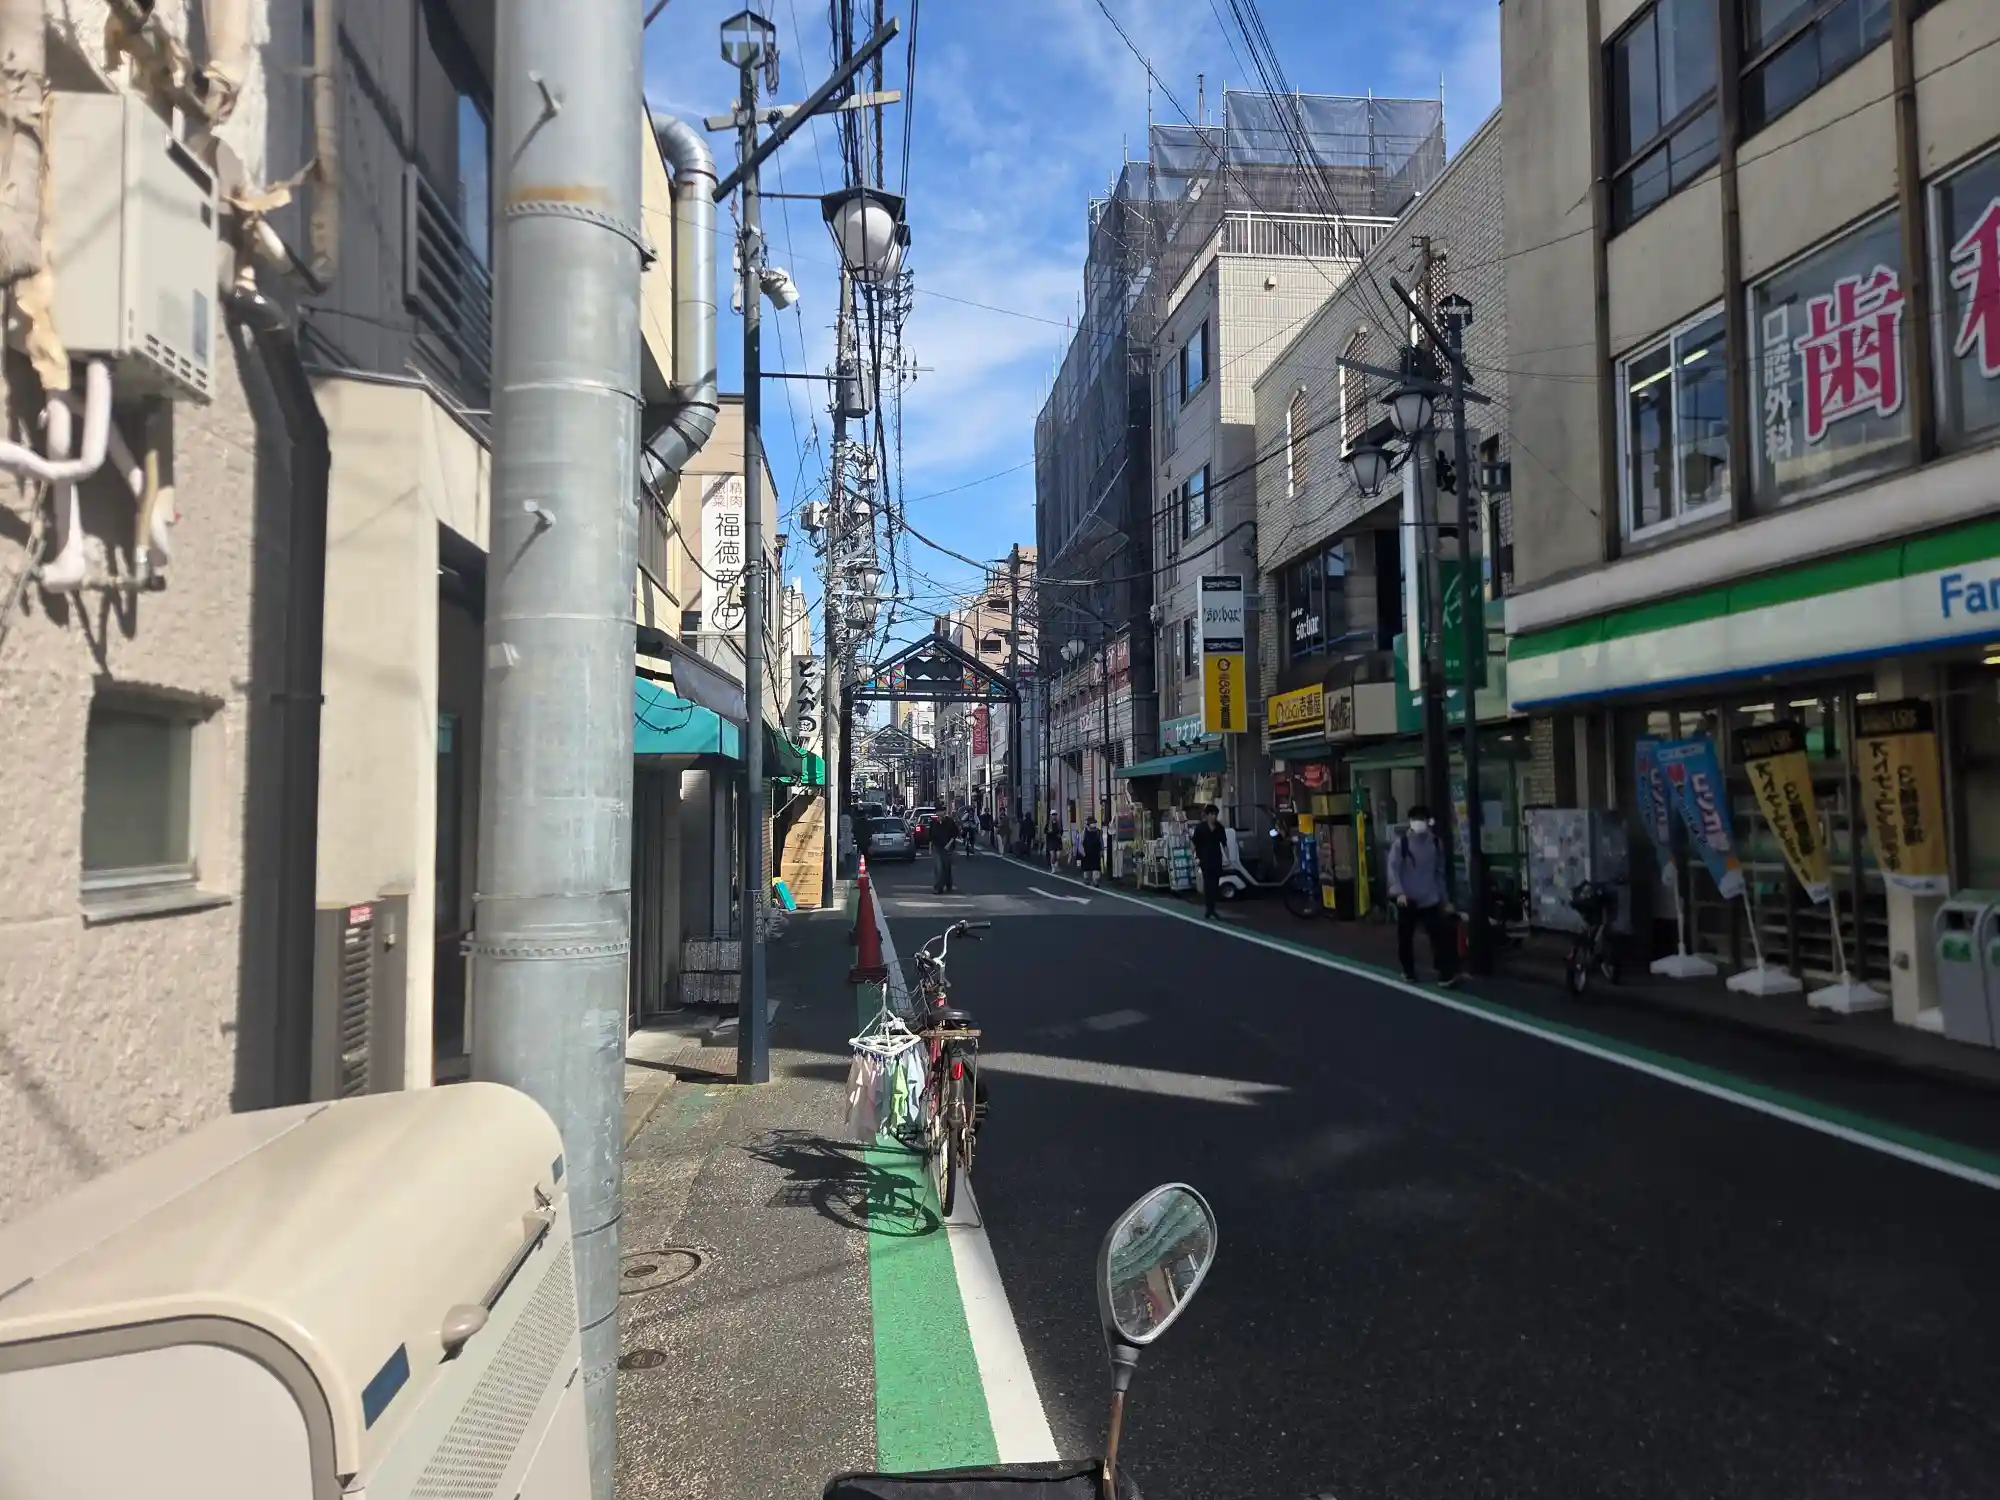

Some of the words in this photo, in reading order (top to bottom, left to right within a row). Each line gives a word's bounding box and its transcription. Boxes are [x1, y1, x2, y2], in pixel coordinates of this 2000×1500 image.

[1762, 303, 1792, 463] 口腔外科
[729, 480, 742, 508] 精肉
[796, 659, 817, 732] とんかつ
